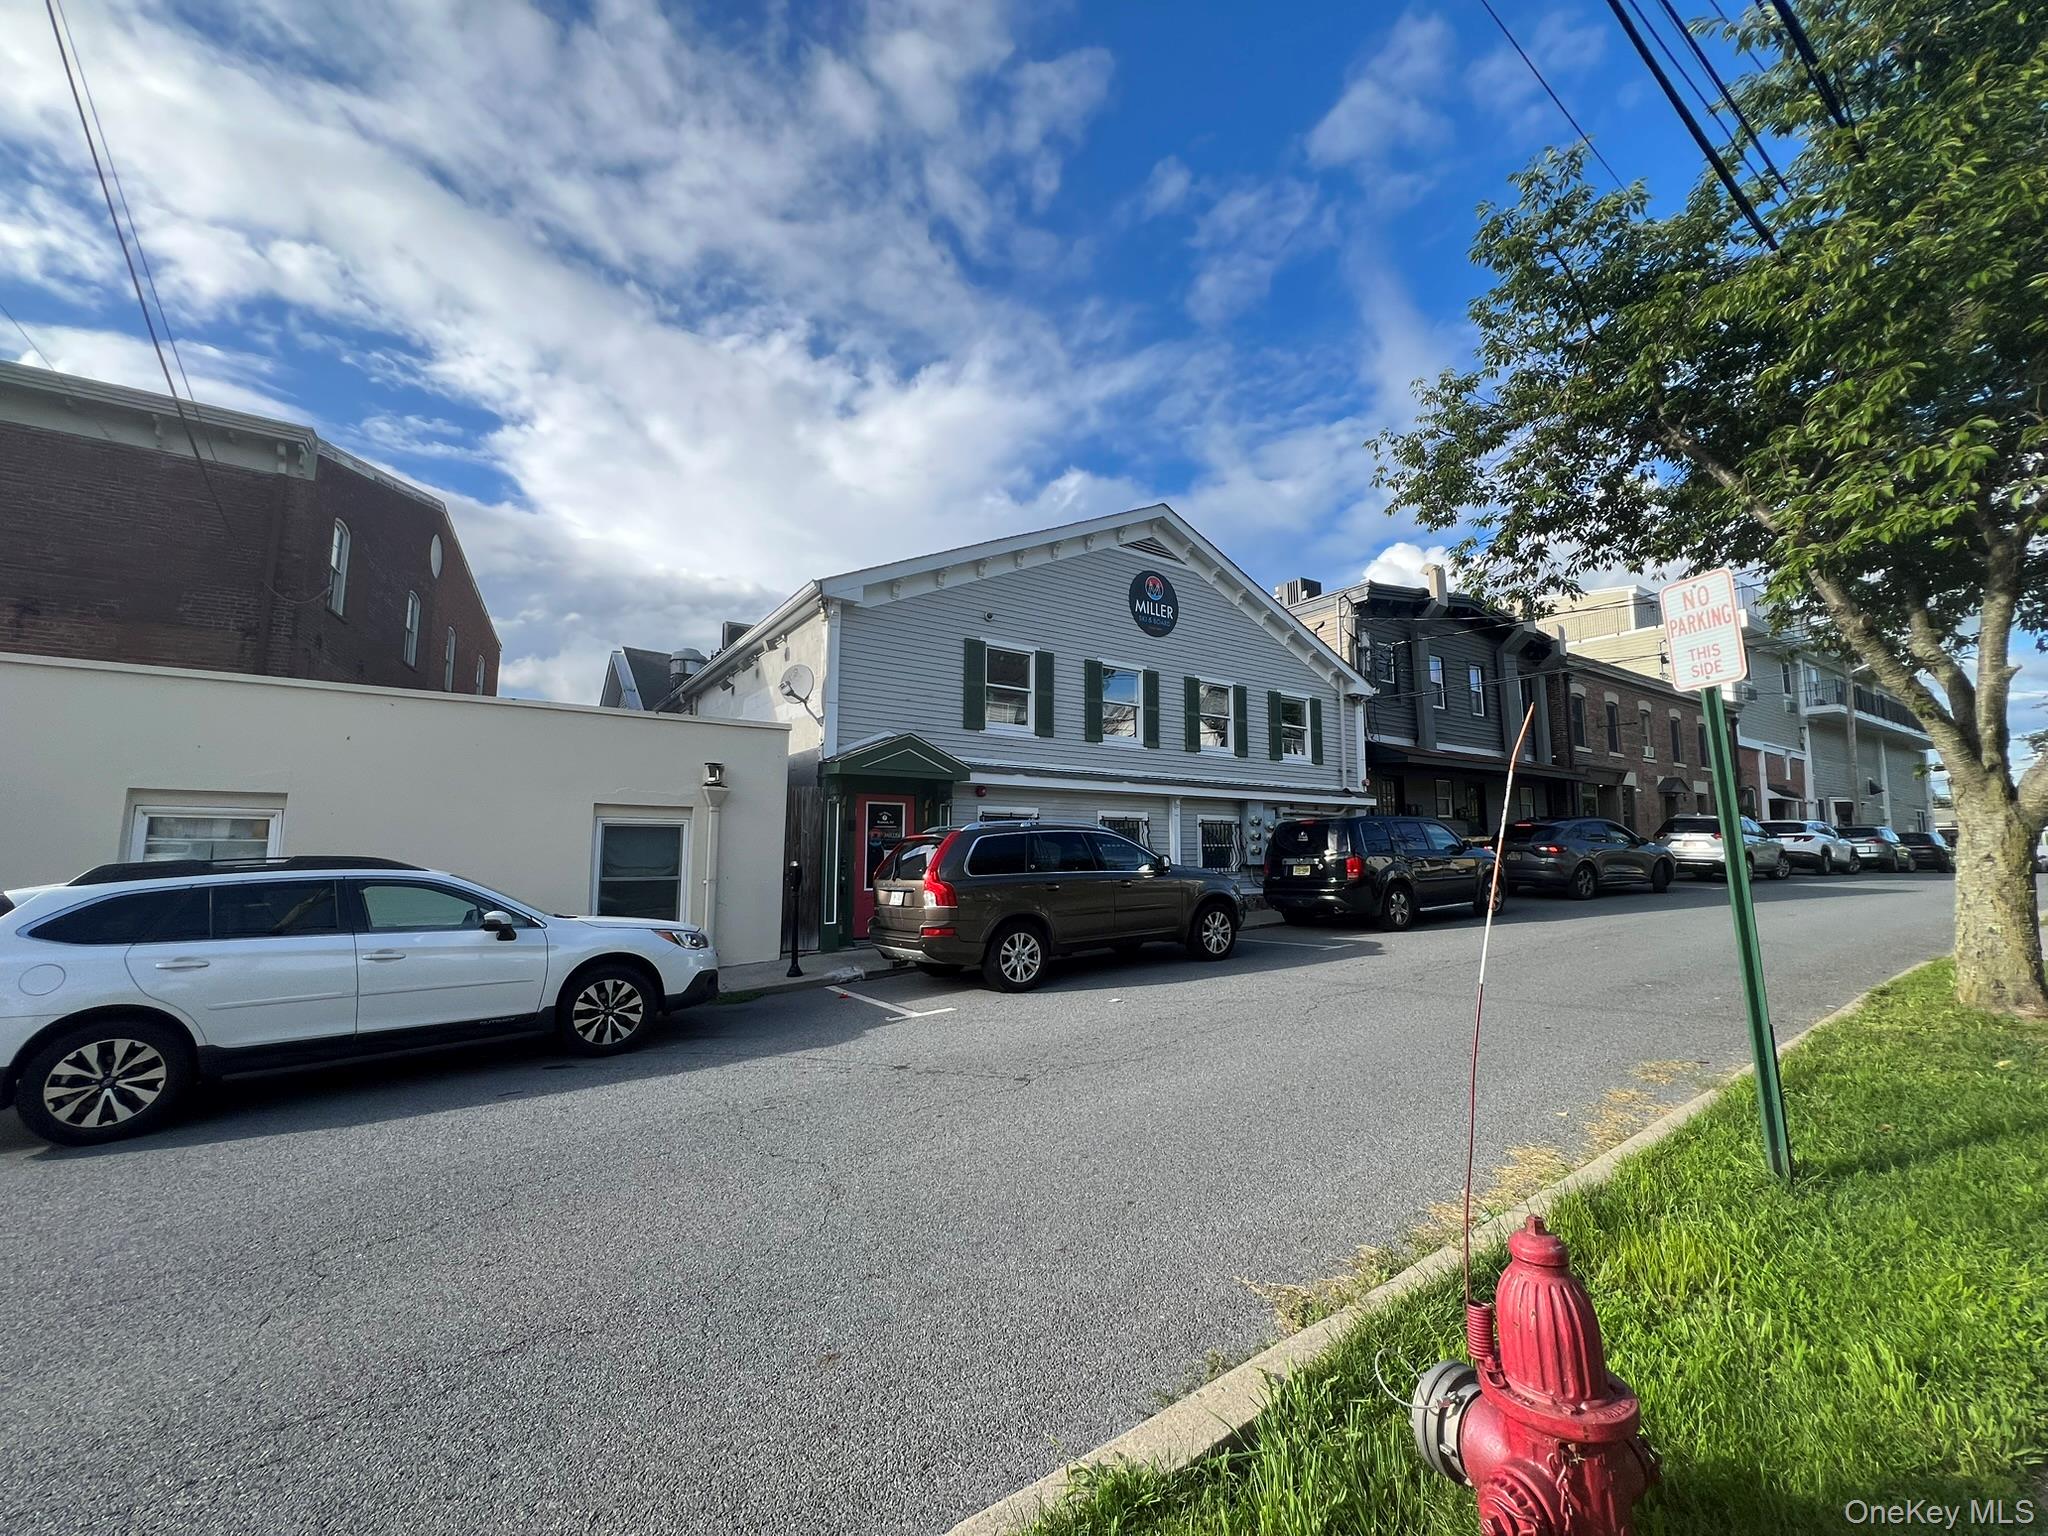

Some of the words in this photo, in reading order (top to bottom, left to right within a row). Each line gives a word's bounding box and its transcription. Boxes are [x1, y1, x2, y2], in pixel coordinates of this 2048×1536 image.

[1682, 585, 1710, 611] NO
[1135, 600, 1173, 619] MILLER
[1669, 604, 1732, 638] PARKING
[1688, 643, 1721, 662] THIS
[1690, 660, 1724, 679] SIDE
